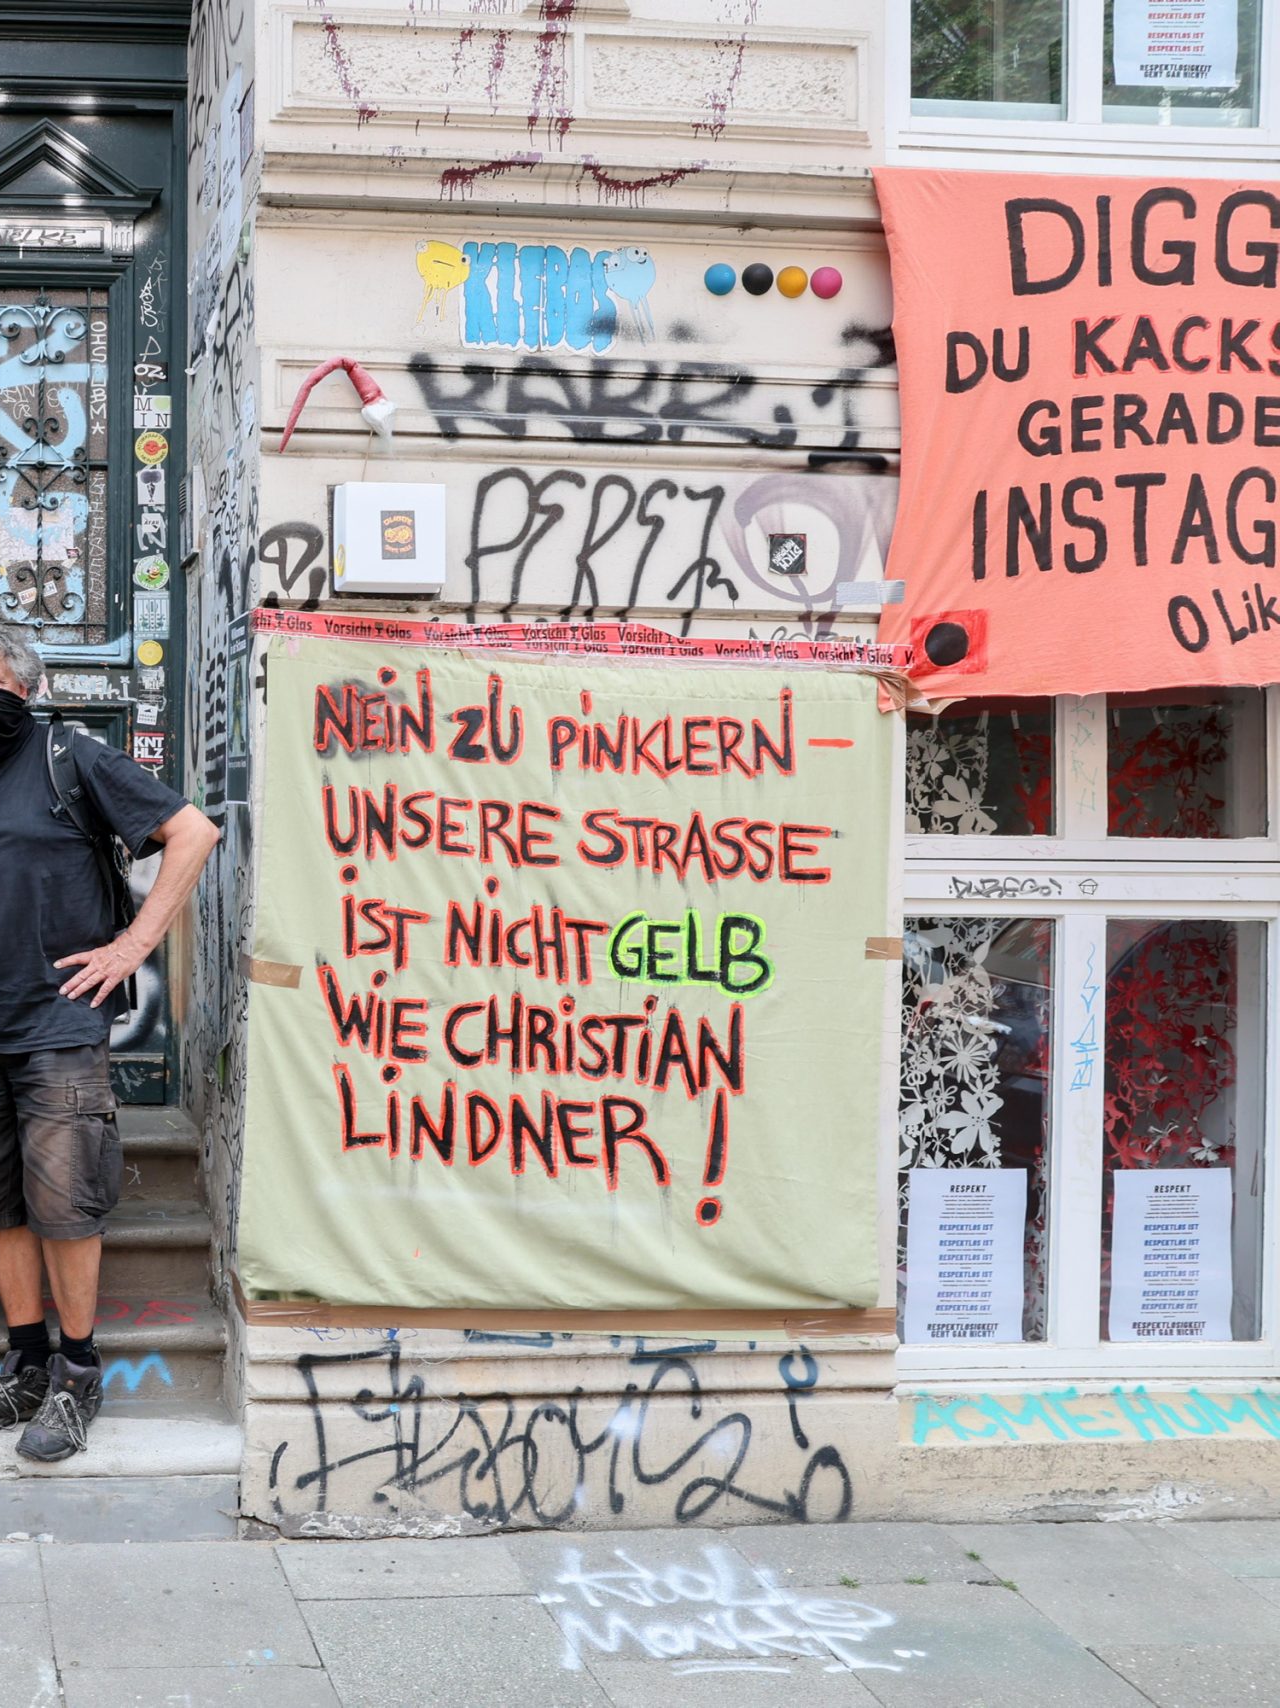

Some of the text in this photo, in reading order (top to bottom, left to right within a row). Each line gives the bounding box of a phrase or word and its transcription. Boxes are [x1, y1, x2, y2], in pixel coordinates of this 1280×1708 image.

[945, 314, 1280, 394] DU KACK
[286, 616, 313, 632] Glas
[324, 618, 372, 636] Vorsicht
[385, 623, 413, 641] Glas
[423, 625, 472, 643] Vorsicht
[519, 625, 569, 643] Vorsicht
[580, 626, 607, 642] Glas
[618, 625, 665, 645] Vorsicht
[713, 643, 762, 660] Vorsicht
[772, 645, 800, 661] Glas
[808, 646, 856, 664] Vorsicht
[865, 649, 894, 666] Glas
[134, 736, 165, 748] KNT
[134, 748, 164, 759] HLZ
[320, 782, 834, 884] UNSERE STRASSE
[607, 907, 776, 1000] GELB
[950, 1185, 987, 1193] RESPEKT
[1154, 1184, 1191, 1193] RESPEKT
[1188, 1223, 1199, 1231] IST
